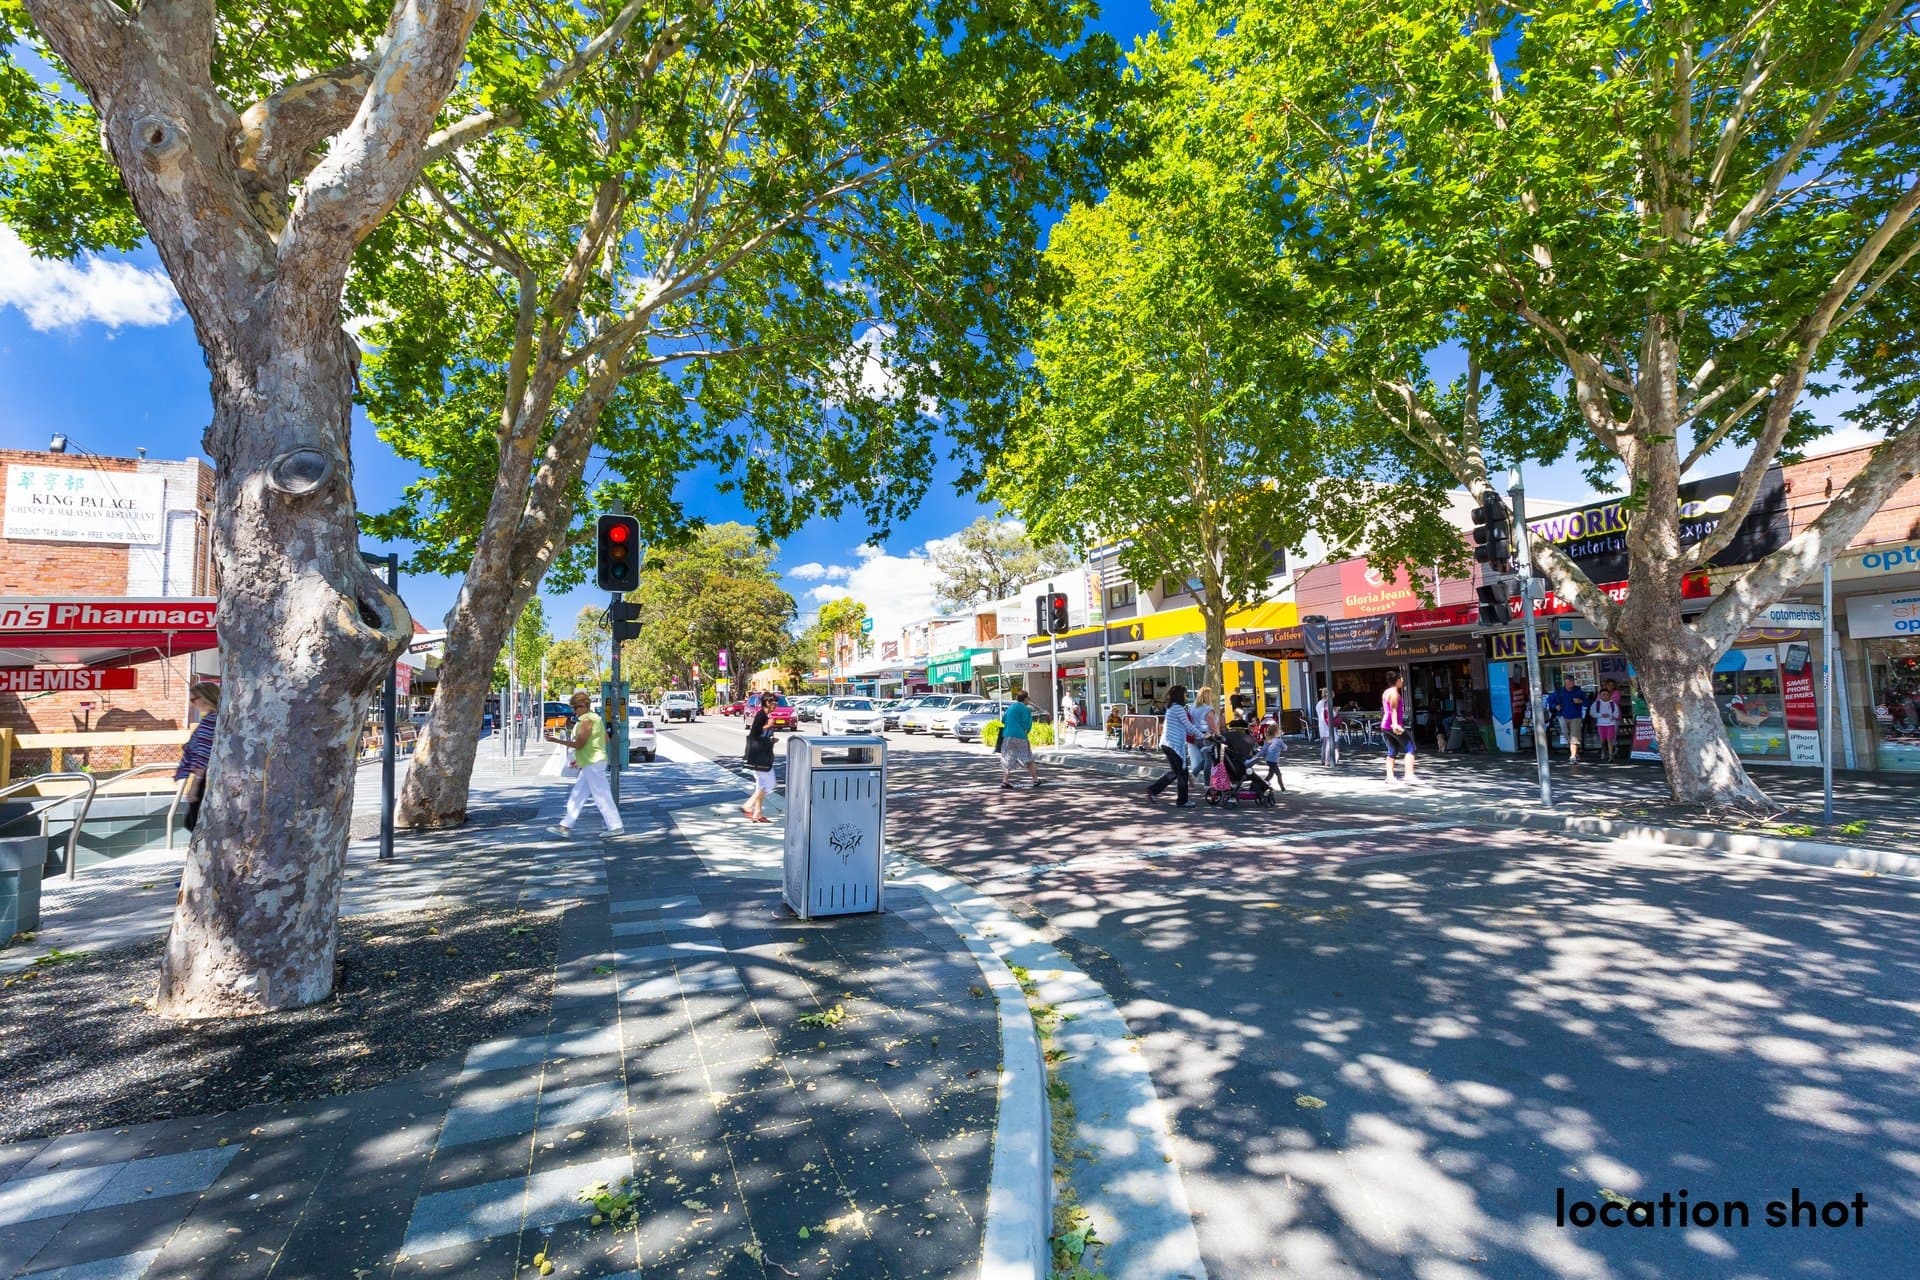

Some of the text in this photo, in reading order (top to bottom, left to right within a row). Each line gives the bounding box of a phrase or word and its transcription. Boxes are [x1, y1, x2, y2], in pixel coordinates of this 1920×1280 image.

[32, 493, 137, 510] KING PALACE
[11, 506, 46, 515] CHINESE
[58, 508, 103, 519] MALAYSIAN
[105, 511, 155, 521] RESTAURANT
[8, 527, 154, 541] DISCOUNT TAKE AWAY FREE HOME DELIVERY
[1346, 587, 1411, 607] Gloria Jean's
[1360, 601, 1396, 612] COFFEES
[0, 604, 217, 628] n's Pharmacy
[1770, 609, 1821, 621] optometrists
[1224, 631, 1302, 648] Gloria Jean's Coffees
[1358, 629, 1378, 638] Coffees
[1385, 642, 1467, 657] Gloria Jean's Coffees
[1786, 679, 1809, 687] SMART
[1786, 685, 1811, 693] PHONE
[1785, 691, 1814, 700] REPAIRS
